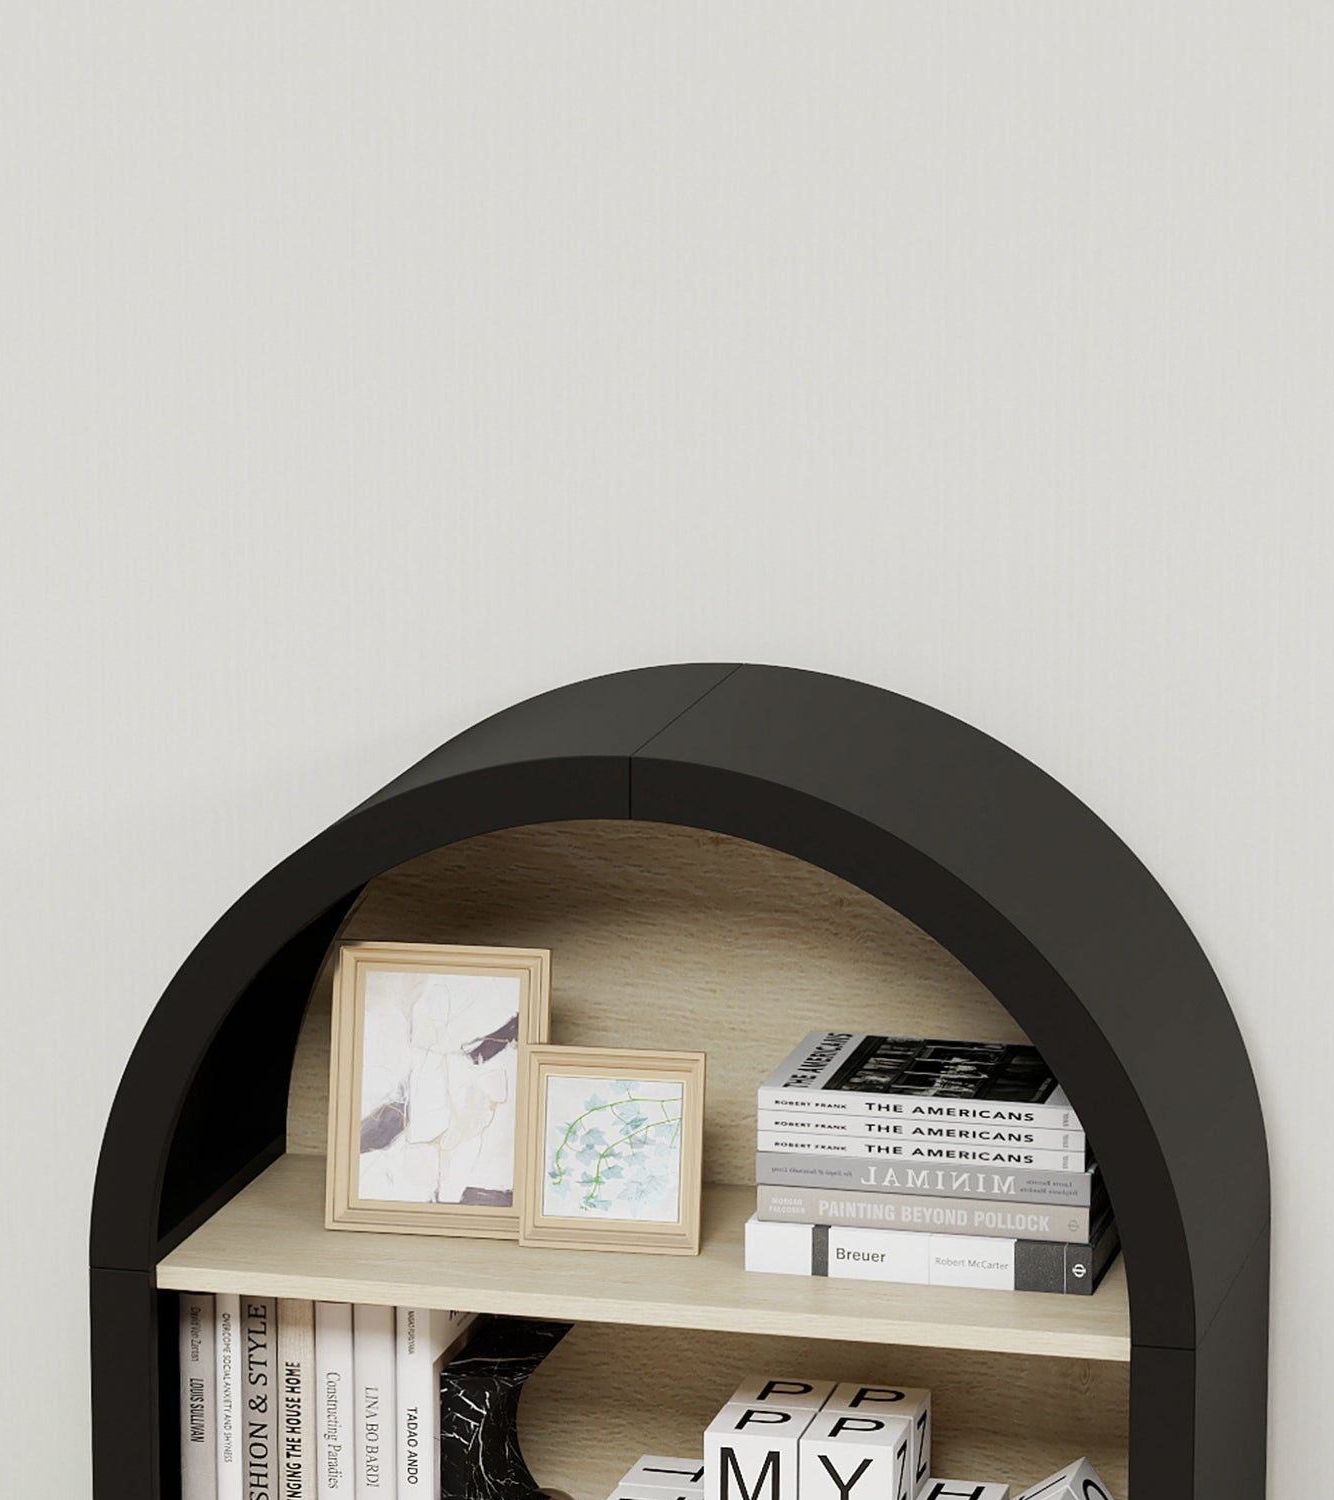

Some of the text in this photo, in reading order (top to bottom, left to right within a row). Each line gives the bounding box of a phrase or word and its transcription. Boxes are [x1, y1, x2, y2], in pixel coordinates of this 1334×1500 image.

[782, 1032, 853, 1088] THE AMERICANS
[865, 1103, 903, 1113] THE
[912, 1106, 1034, 1121] AMERICANS
[865, 1124, 903, 1134] THE
[912, 1128, 1034, 1142] AMERICANS
[865, 1144, 903, 1155] THE
[912, 1148, 1034, 1164] AMERICANS
[819, 1200, 1050, 1232] PAINTING BEYOND POLLOCK
[836, 1248, 886, 1262] Breuer
[935, 1257, 1009, 1270] Robert McCarter
[248, 1304, 267, 1386] STYLE
[222, 1313, 233, 1463] OVERCOME SOCIAL ANXIETY AND SHYNESS
[285, 1362, 301, 1394] HOME
[190, 1378, 205, 1442] LOUIS SULLIVAN
[248, 1394, 267, 1414] &
[323, 1372, 341, 1441] Constructing
[756, 1381, 905, 1408] P P
[285, 1397, 301, 1434] HOUSE
[734, 1409, 885, 1437] P P
[286, 1437, 302, 1458] THE
[365, 1387, 379, 1487] LINA BO BARDI
[406, 1406, 418, 1485] TADAO ANDO
